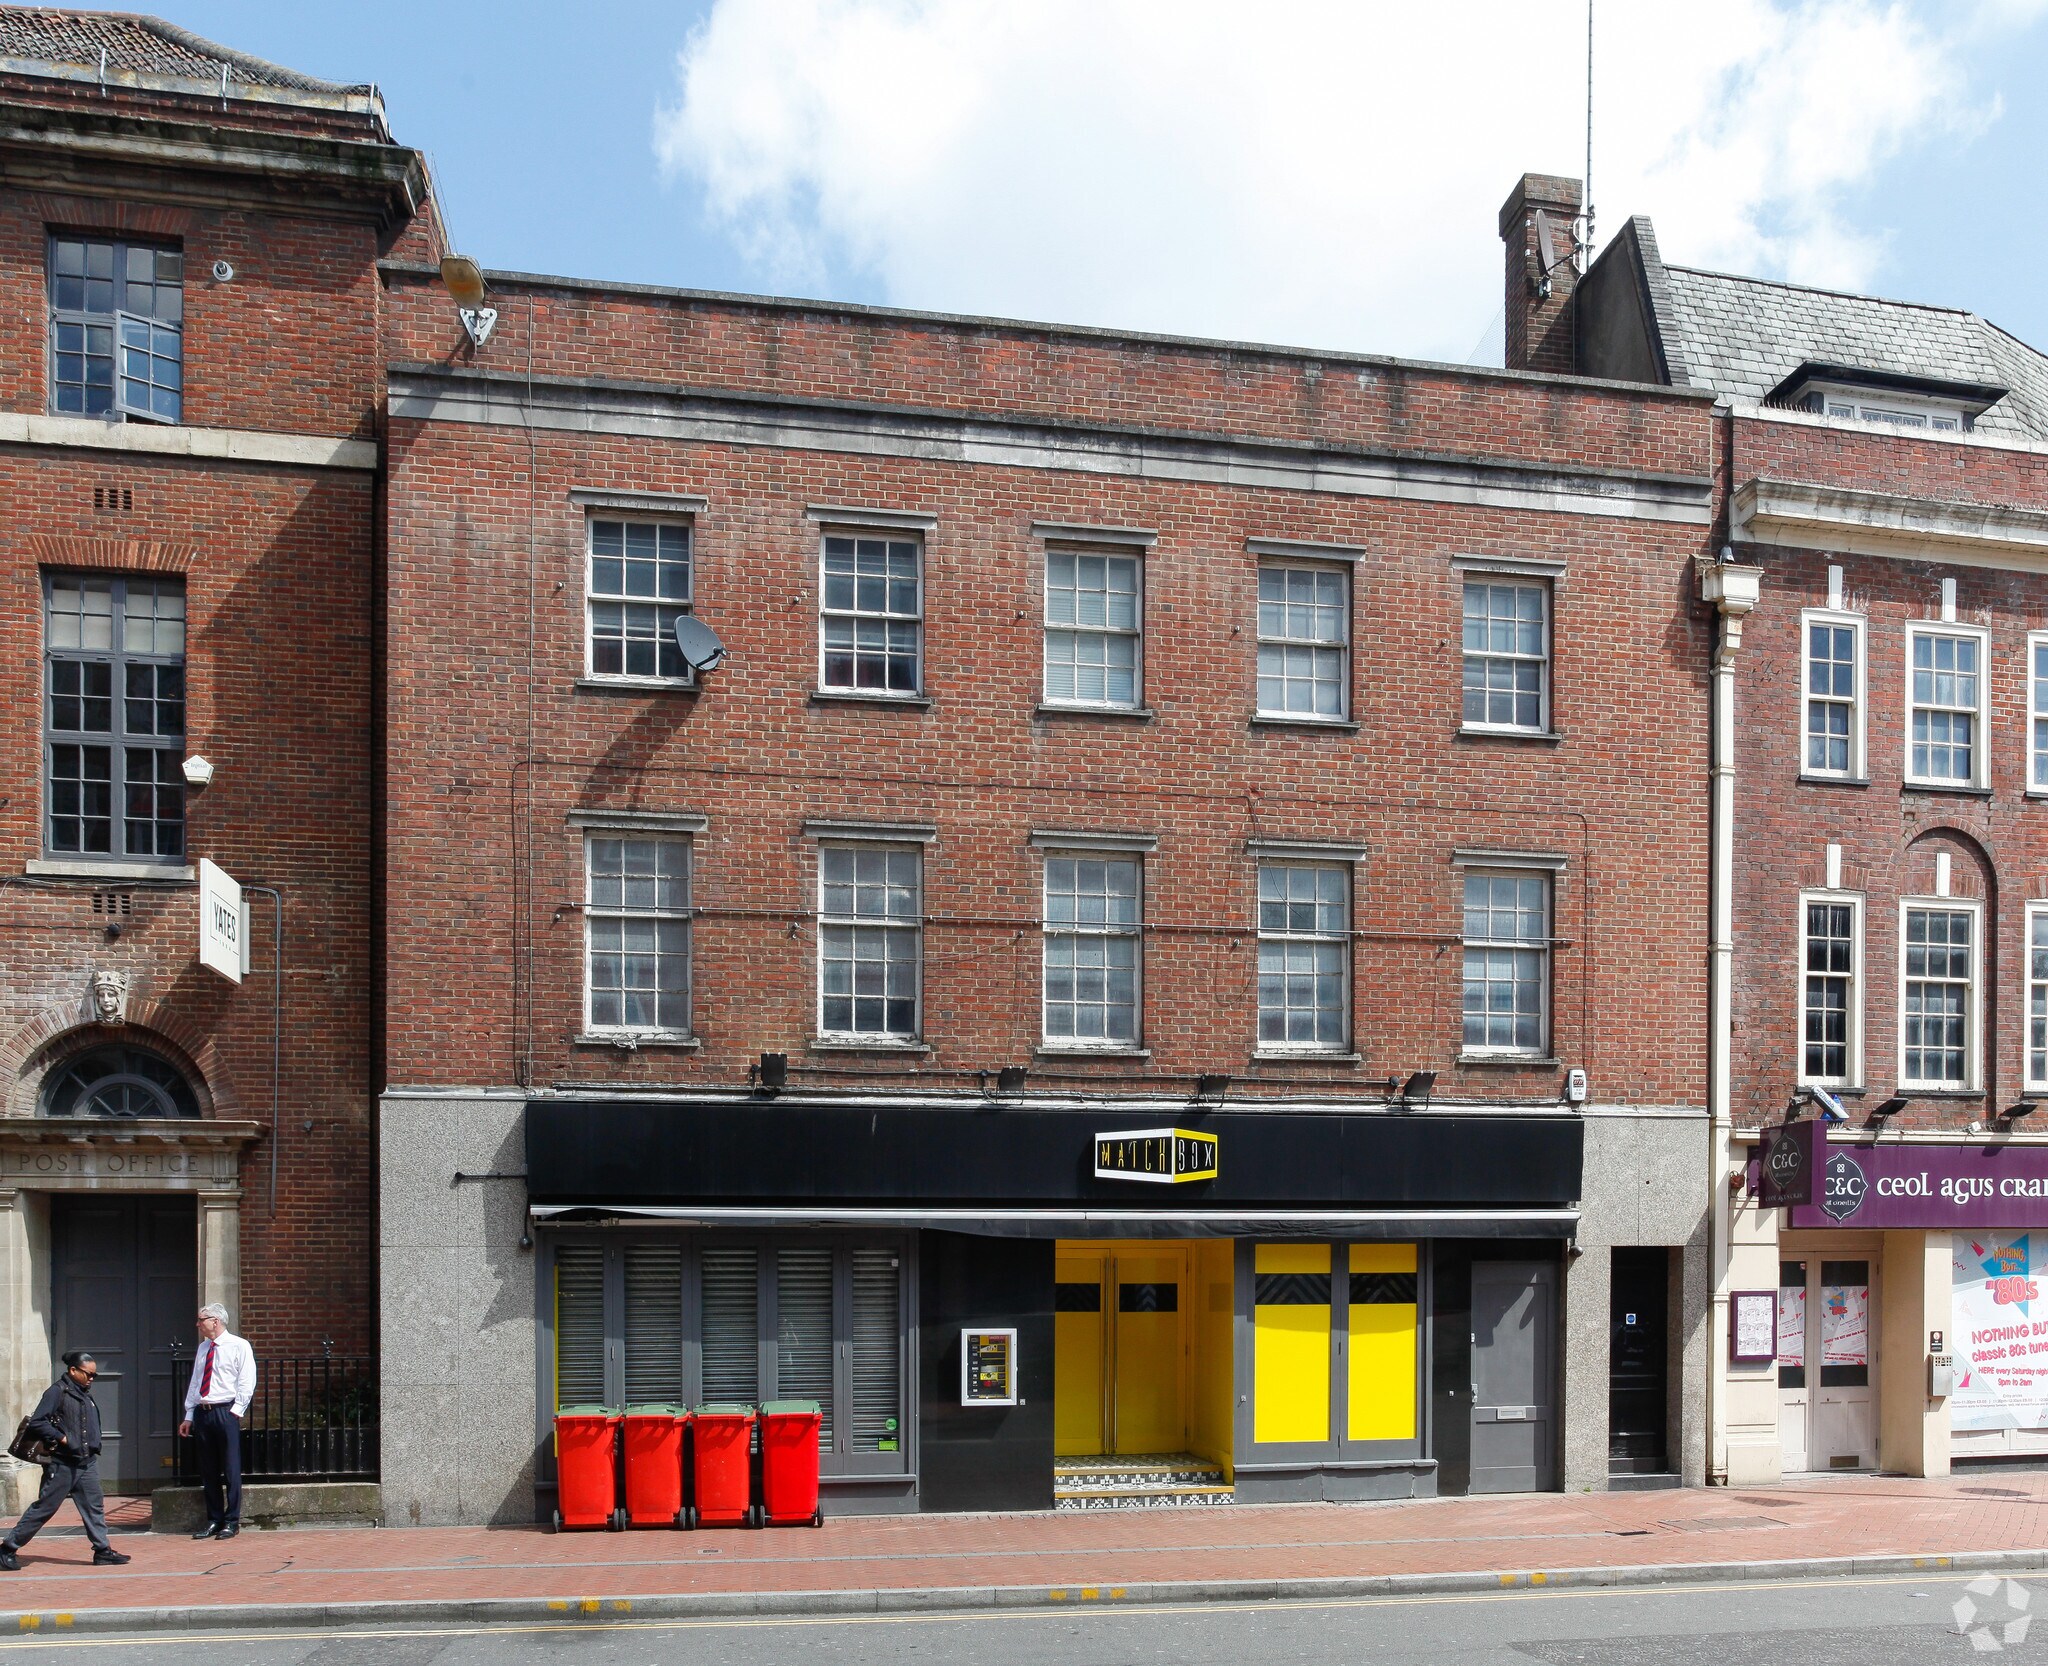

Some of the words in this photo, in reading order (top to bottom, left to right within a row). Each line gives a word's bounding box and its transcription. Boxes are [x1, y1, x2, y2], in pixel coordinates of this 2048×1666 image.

[213, 901, 236, 943] YATES
[19, 1153, 88, 1171] POST
[107, 1153, 199, 1172] OFFICE
[1772, 1152, 1798, 1170] C&C
[1971, 1324, 2030, 1345] NOTHING
[1971, 1346, 2007, 1363] classic
[2009, 1343, 2027, 1358] 80s
[1978, 1366, 1995, 1375] HERE
[1996, 1368, 2011, 1376] every
[2011, 1367, 2036, 1377] Saturday
